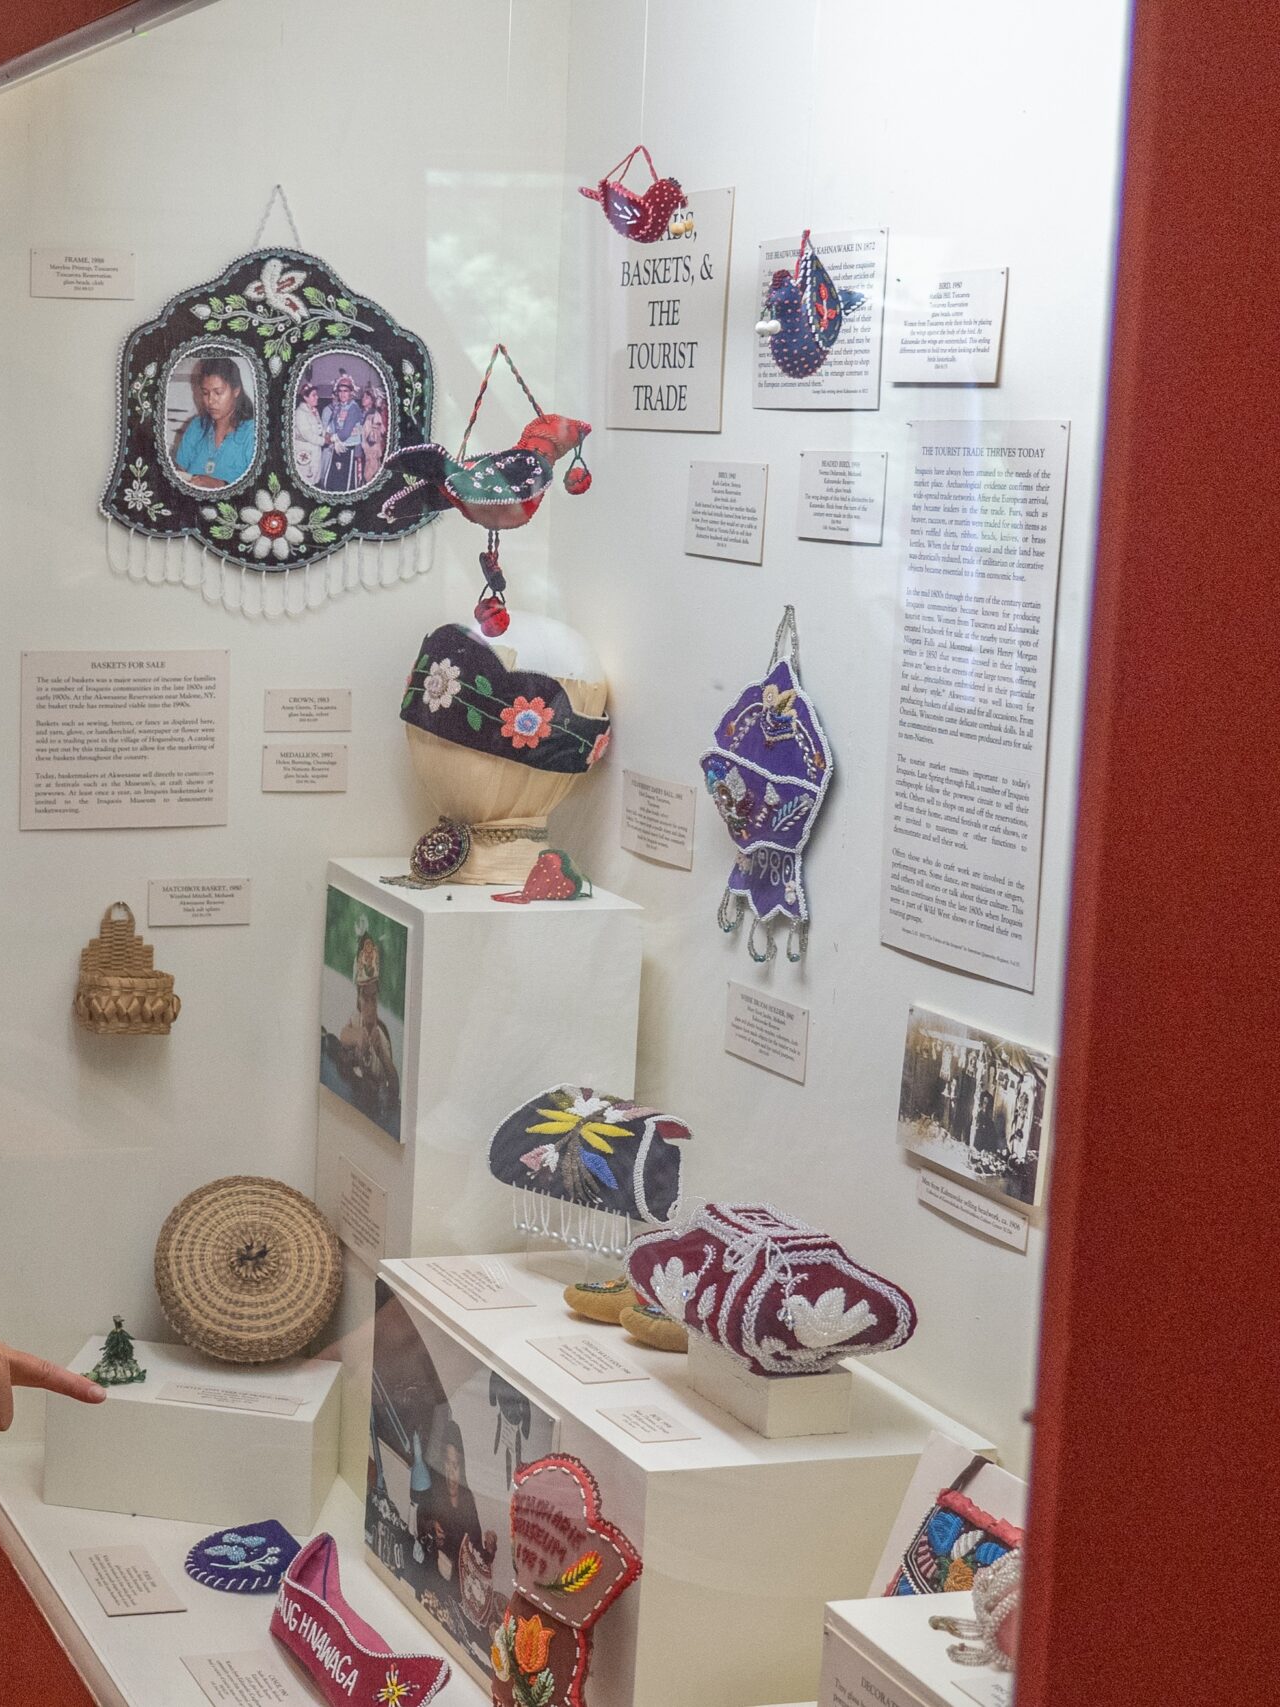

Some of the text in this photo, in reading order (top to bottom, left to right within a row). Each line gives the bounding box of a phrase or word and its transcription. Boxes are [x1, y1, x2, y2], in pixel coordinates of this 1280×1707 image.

[817, 243, 854, 255] KAHNAWAKE
[855, 243, 862, 252] IN
[621, 253, 713, 286] BASKETS, &
[648, 299, 680, 326] THE
[627, 341, 698, 369] TOURIST
[633, 384, 687, 411] TRADE
[922, 446, 1044, 458] THE TOURIST TRADE THRIVES TODAY
